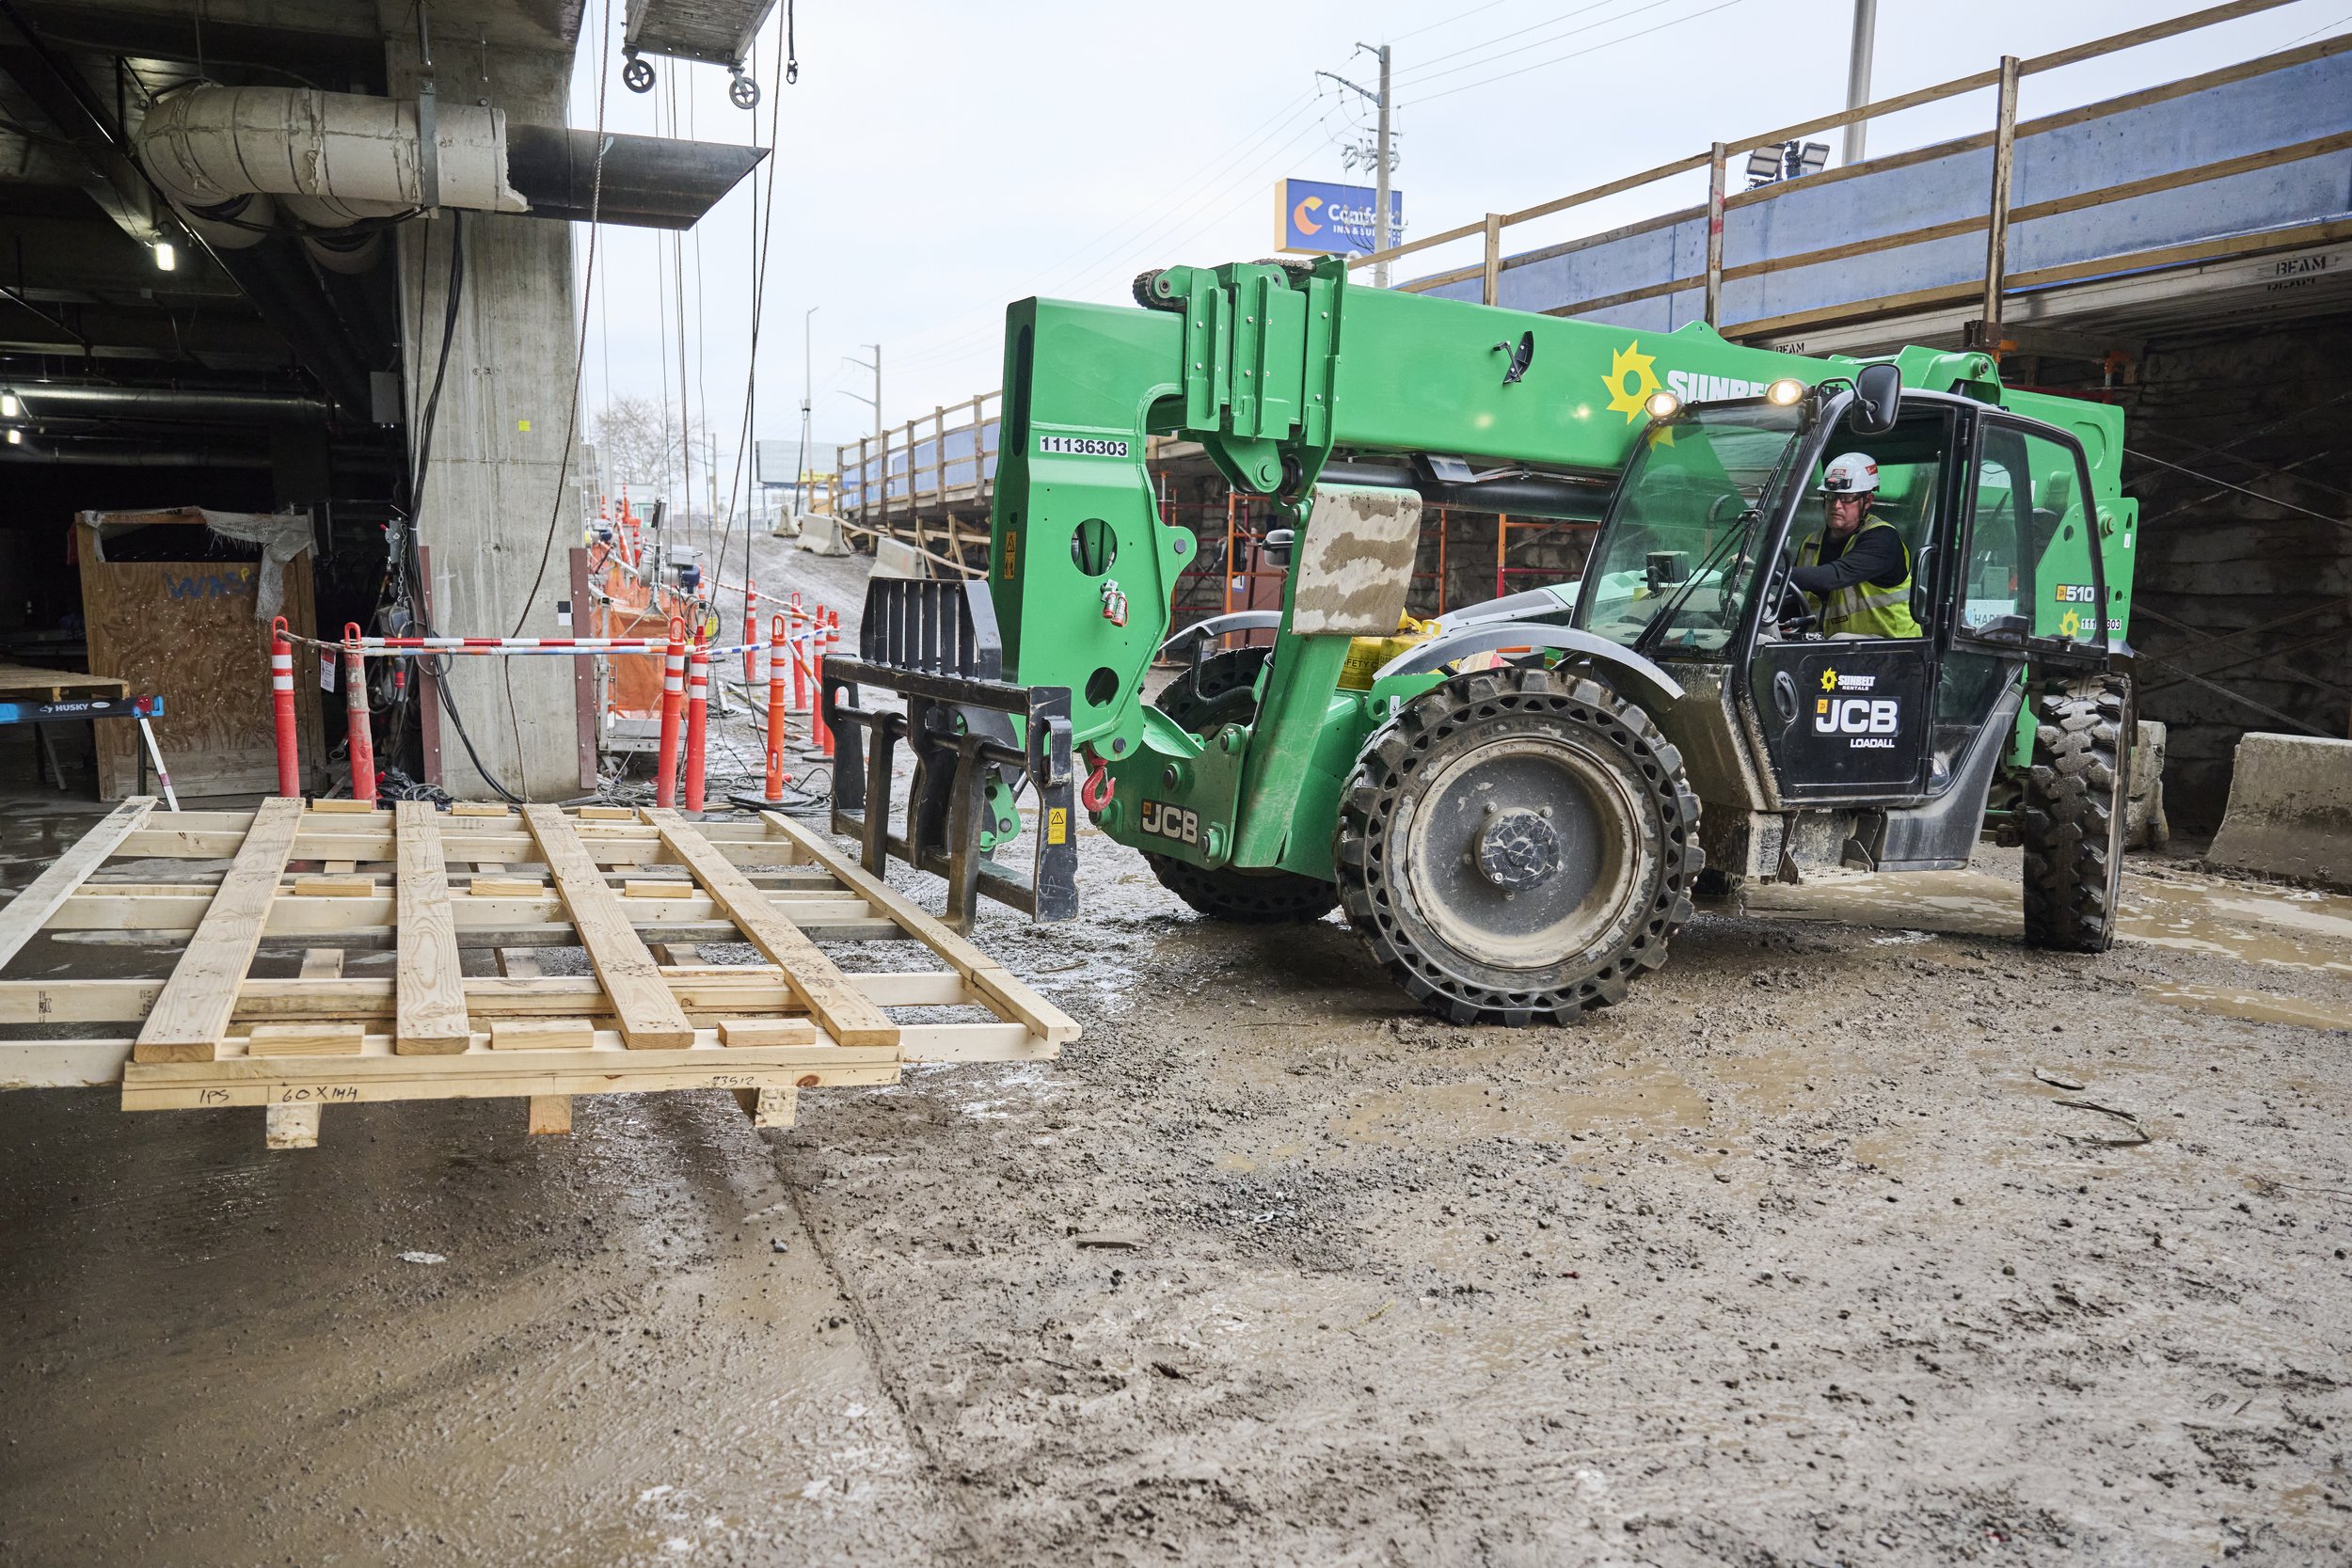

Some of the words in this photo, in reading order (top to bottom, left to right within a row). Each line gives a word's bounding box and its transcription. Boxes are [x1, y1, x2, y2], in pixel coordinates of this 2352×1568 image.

[1327, 204, 1394, 225] Comfo
[2277, 256, 2326, 276] BEAM
[1041, 436, 1128, 457] 11136303
[2081, 618, 2121, 629] 111303
[1837, 674, 1876, 687] SUNBELT
[55, 703, 89, 713] HUSKY
[1815, 699, 1899, 733] JCB
[1850, 738, 1896, 749] LOADALL
[1142, 803, 1199, 845] JCB
